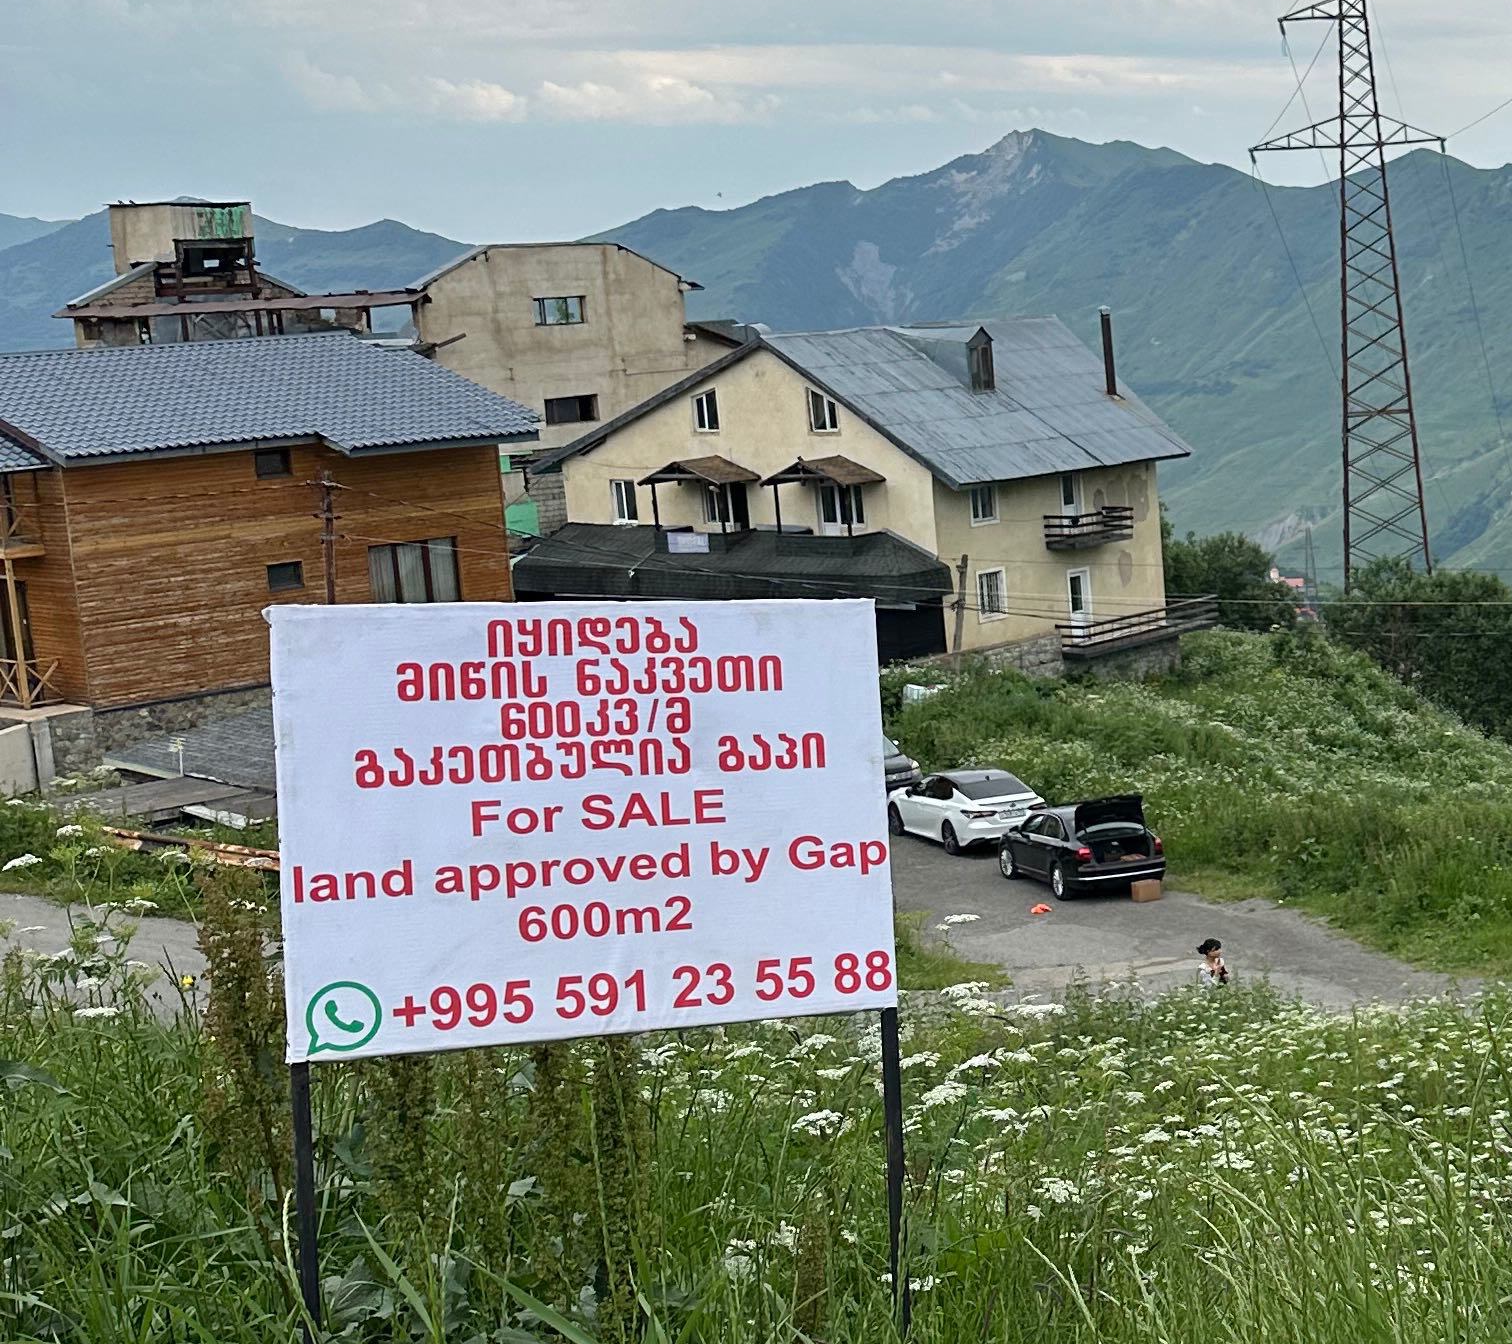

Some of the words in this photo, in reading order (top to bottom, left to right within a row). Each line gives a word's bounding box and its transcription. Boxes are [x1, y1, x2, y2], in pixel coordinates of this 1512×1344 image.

[487, 616, 698, 657] იყიდება
[397, 659, 548, 702] მიწის
[576, 655, 783, 696] ნაკვეთი
[500, 695, 691, 741] 600კვ/მ
[719, 732, 826, 773] გაპი
[471, 800, 563, 837] For
[582, 788, 727, 831] SALE
[293, 859, 414, 903] land
[435, 843, 690, 901] approved
[711, 842, 770, 883] by
[788, 835, 888, 875] Gap
[518, 895, 693, 942] 600m2
[392, 979, 534, 1031] +995
[556, 969, 647, 1019] 591
[672, 962, 735, 1008] 23
[756, 956, 816, 1001] 55
[834, 950, 893, 994] 88
